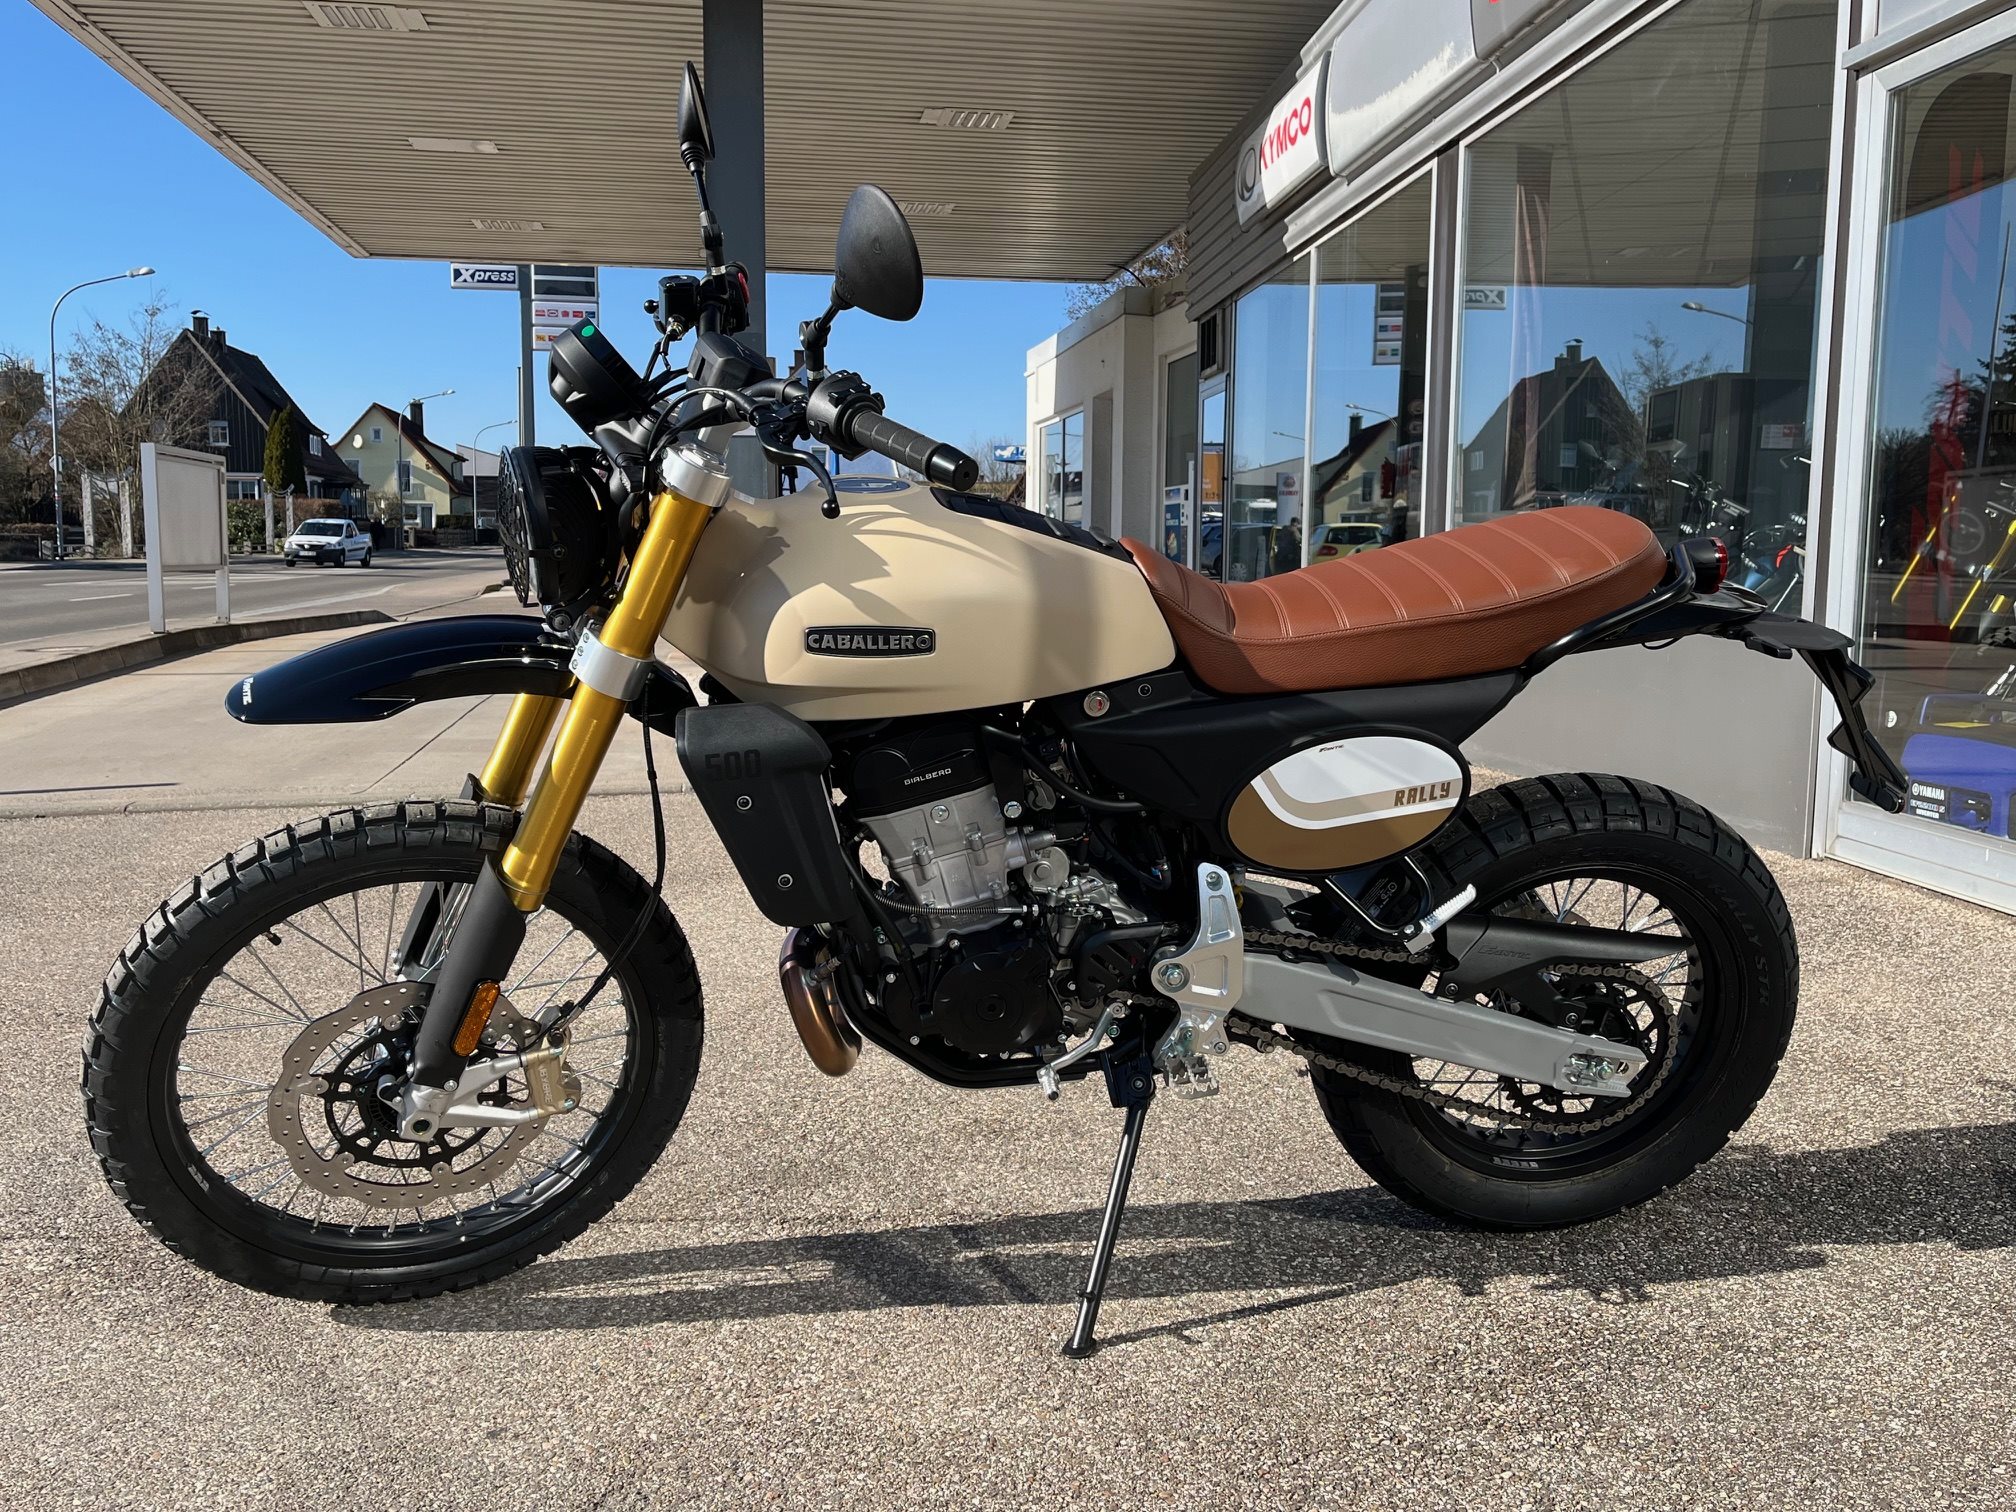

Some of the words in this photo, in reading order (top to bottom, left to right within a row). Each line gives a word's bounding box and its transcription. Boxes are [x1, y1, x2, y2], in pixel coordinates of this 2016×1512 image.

[1260, 97, 1311, 170] KYMCO
[455, 268, 515, 283] Xpress
[807, 634, 932, 650] CABALLERO
[704, 749, 761, 781] 500
[1394, 782, 1451, 806] RALLY
[1919, 785, 1945, 800] YAMAHA
